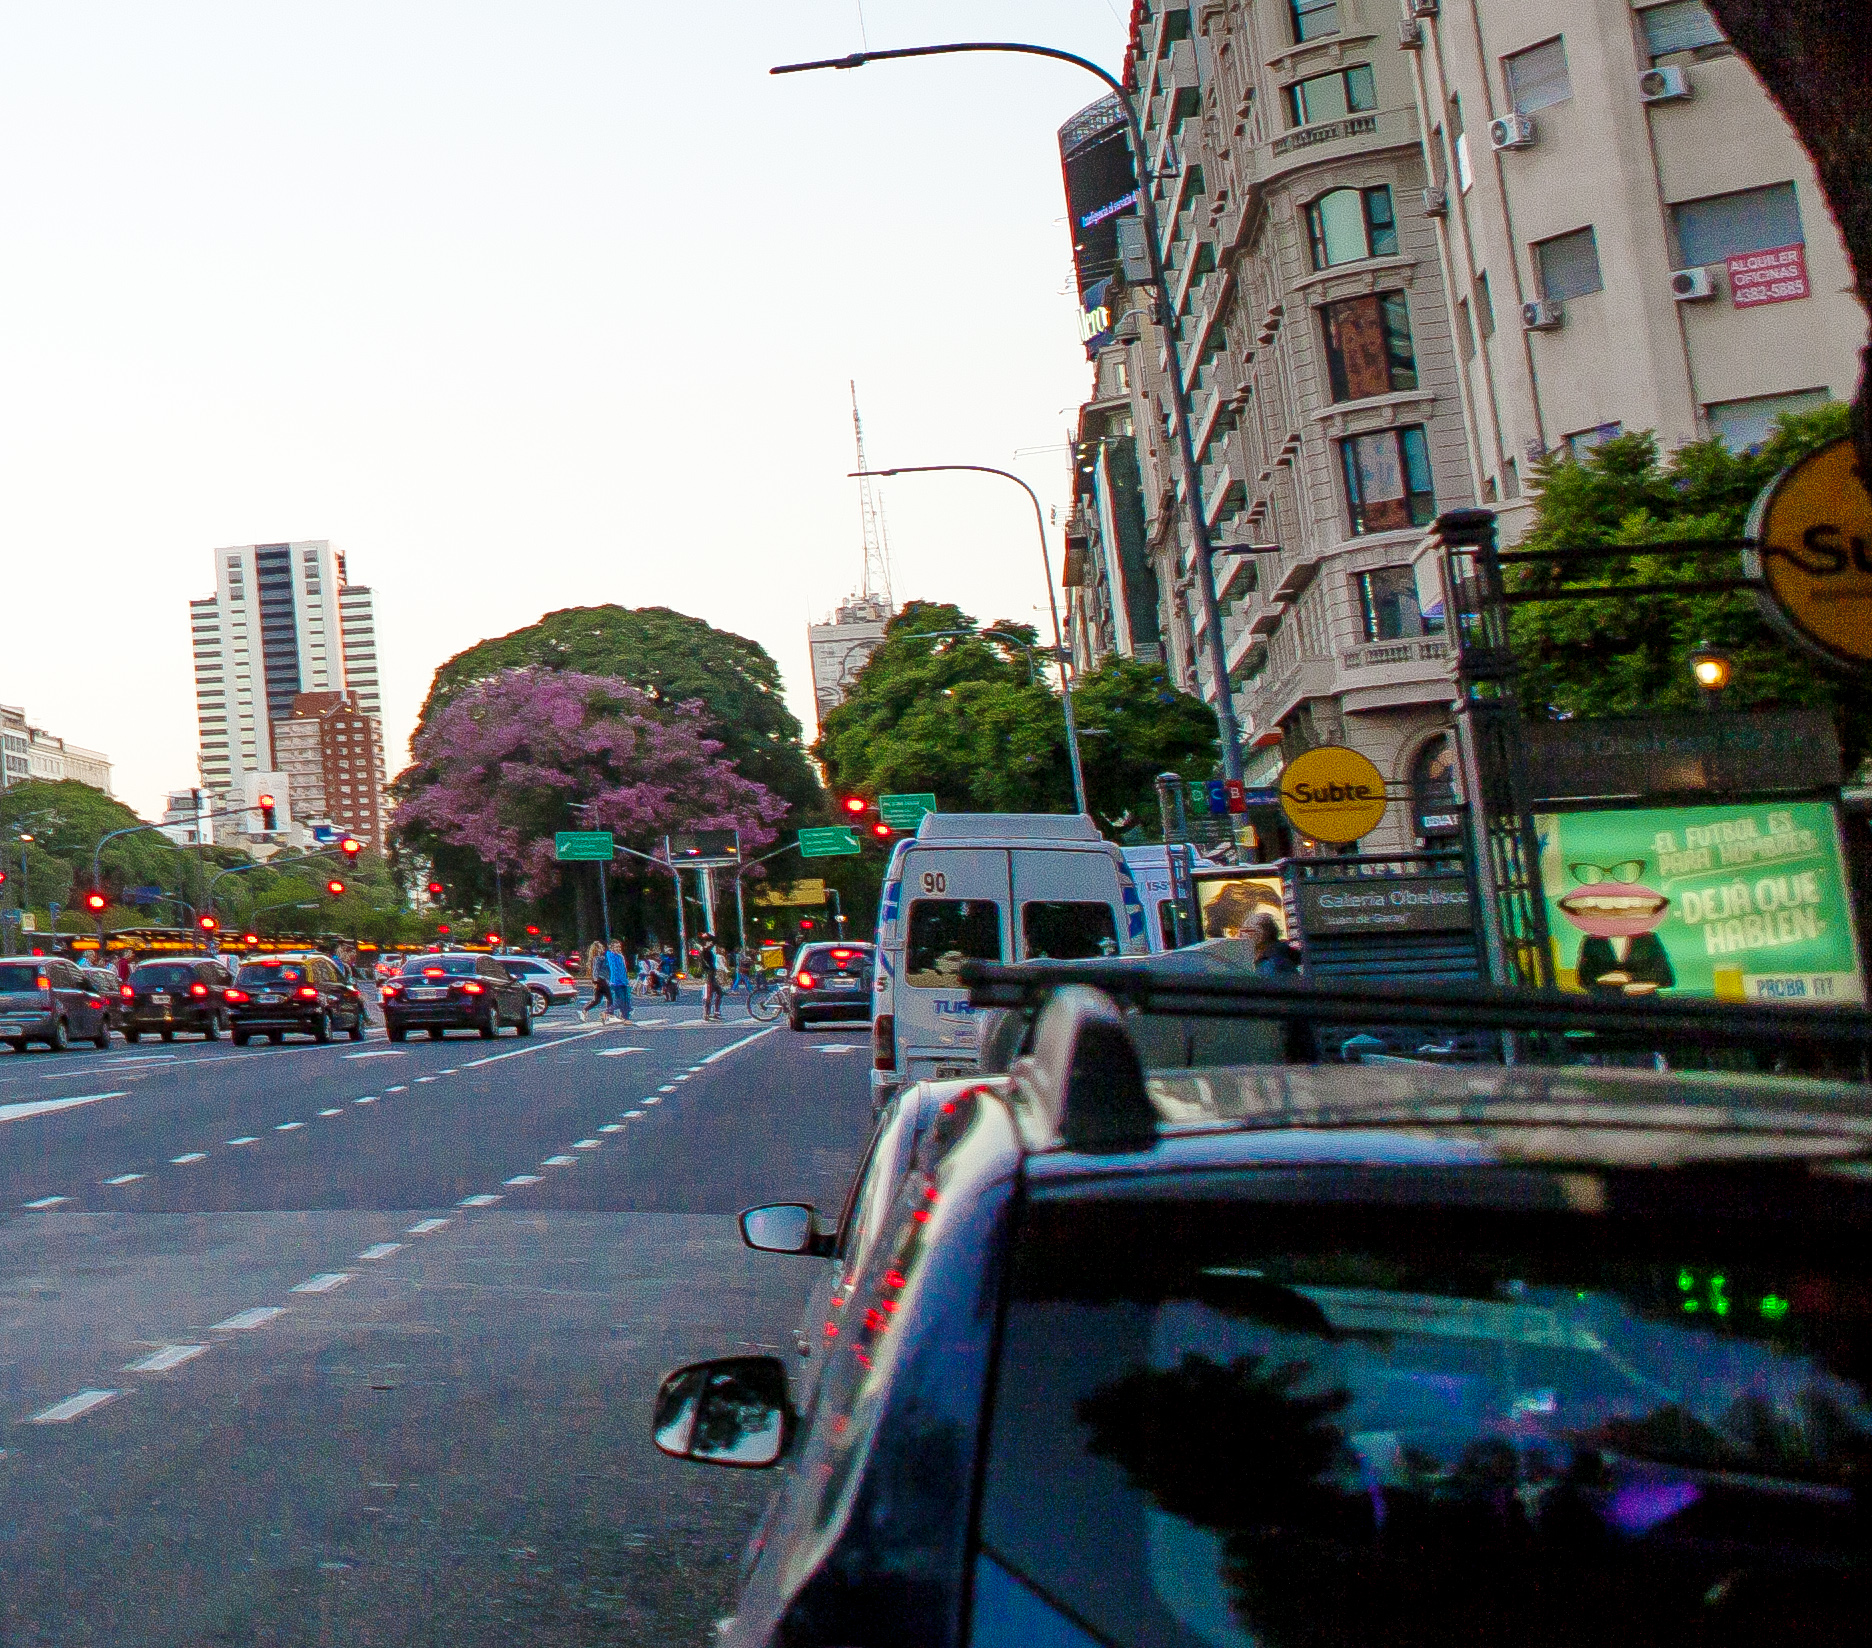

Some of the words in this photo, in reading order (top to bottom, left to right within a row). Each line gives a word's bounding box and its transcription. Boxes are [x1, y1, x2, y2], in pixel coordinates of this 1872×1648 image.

[1730, 251, 1797, 271] ALQUILER
[1735, 265, 1797, 286] OFICINAS
[1295, 781, 1369, 803] Subte
[923, 872, 946, 893] 90
[1755, 869, 1821, 911] QUE
